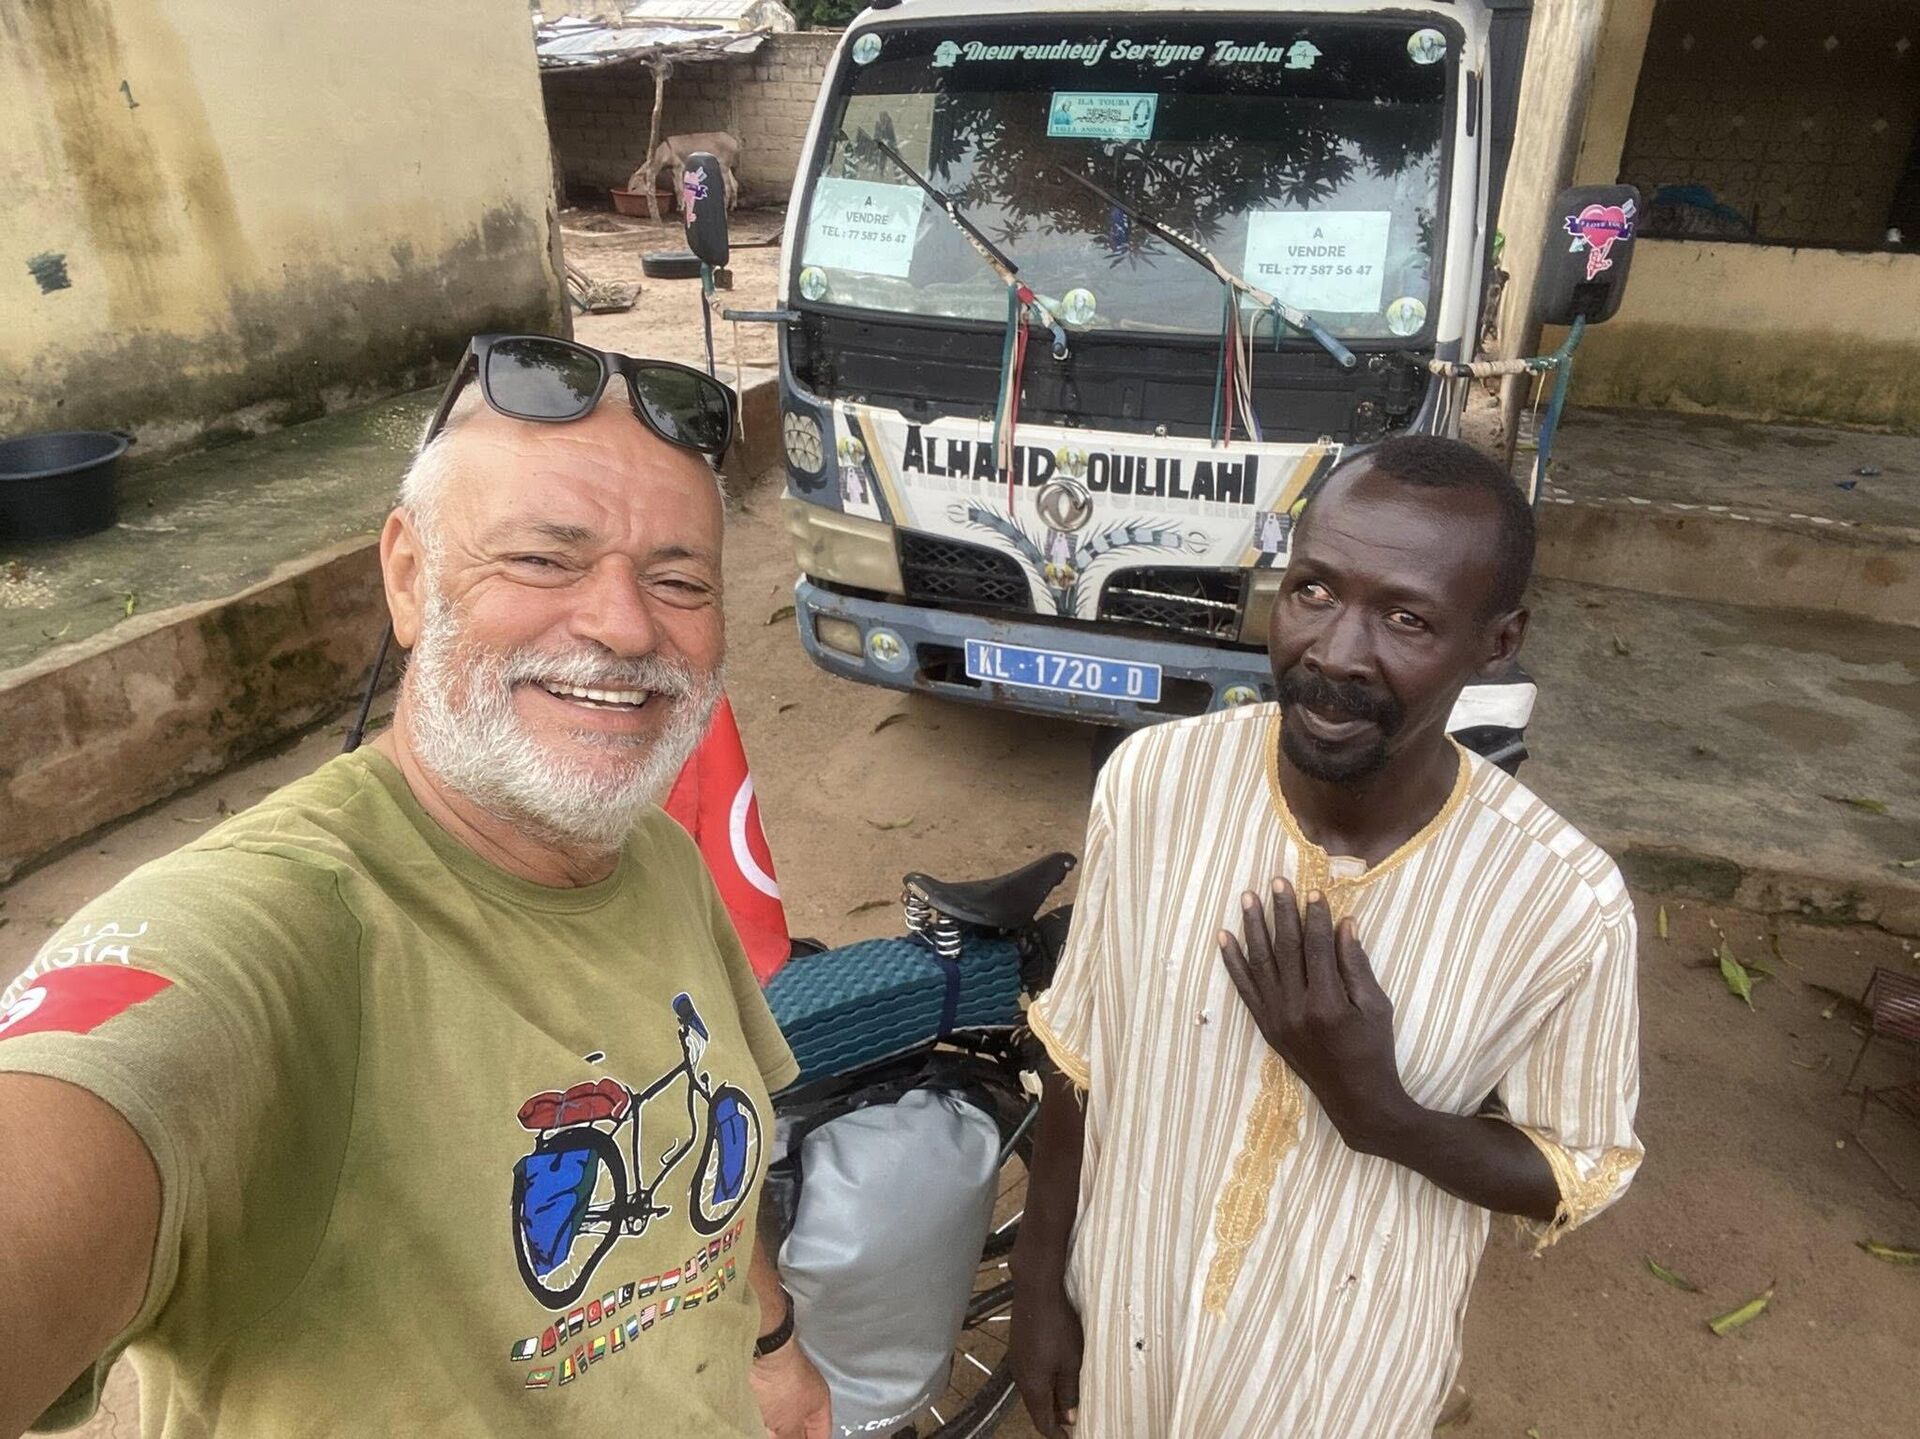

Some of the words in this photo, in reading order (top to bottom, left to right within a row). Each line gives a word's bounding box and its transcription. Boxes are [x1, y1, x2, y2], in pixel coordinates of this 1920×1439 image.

[1110, 39, 1204, 67] Serigne
[1215, 40, 1285, 63] Touba
[864, 196, 873, 206] A
[846, 211, 889, 225] VENDRE
[848, 229, 860, 240] 77
[861, 231, 879, 242] 587
[880, 233, 893, 242] 56
[1313, 227, 1324, 239] A
[1287, 245, 1346, 257] VENDRE
[1293, 265, 1307, 275] 77
[1310, 265, 1334, 275] 587
[1336, 265, 1353, 275] 56
[1356, 265, 1373, 275] 47
[1035, 654, 1102, 691] 1720
